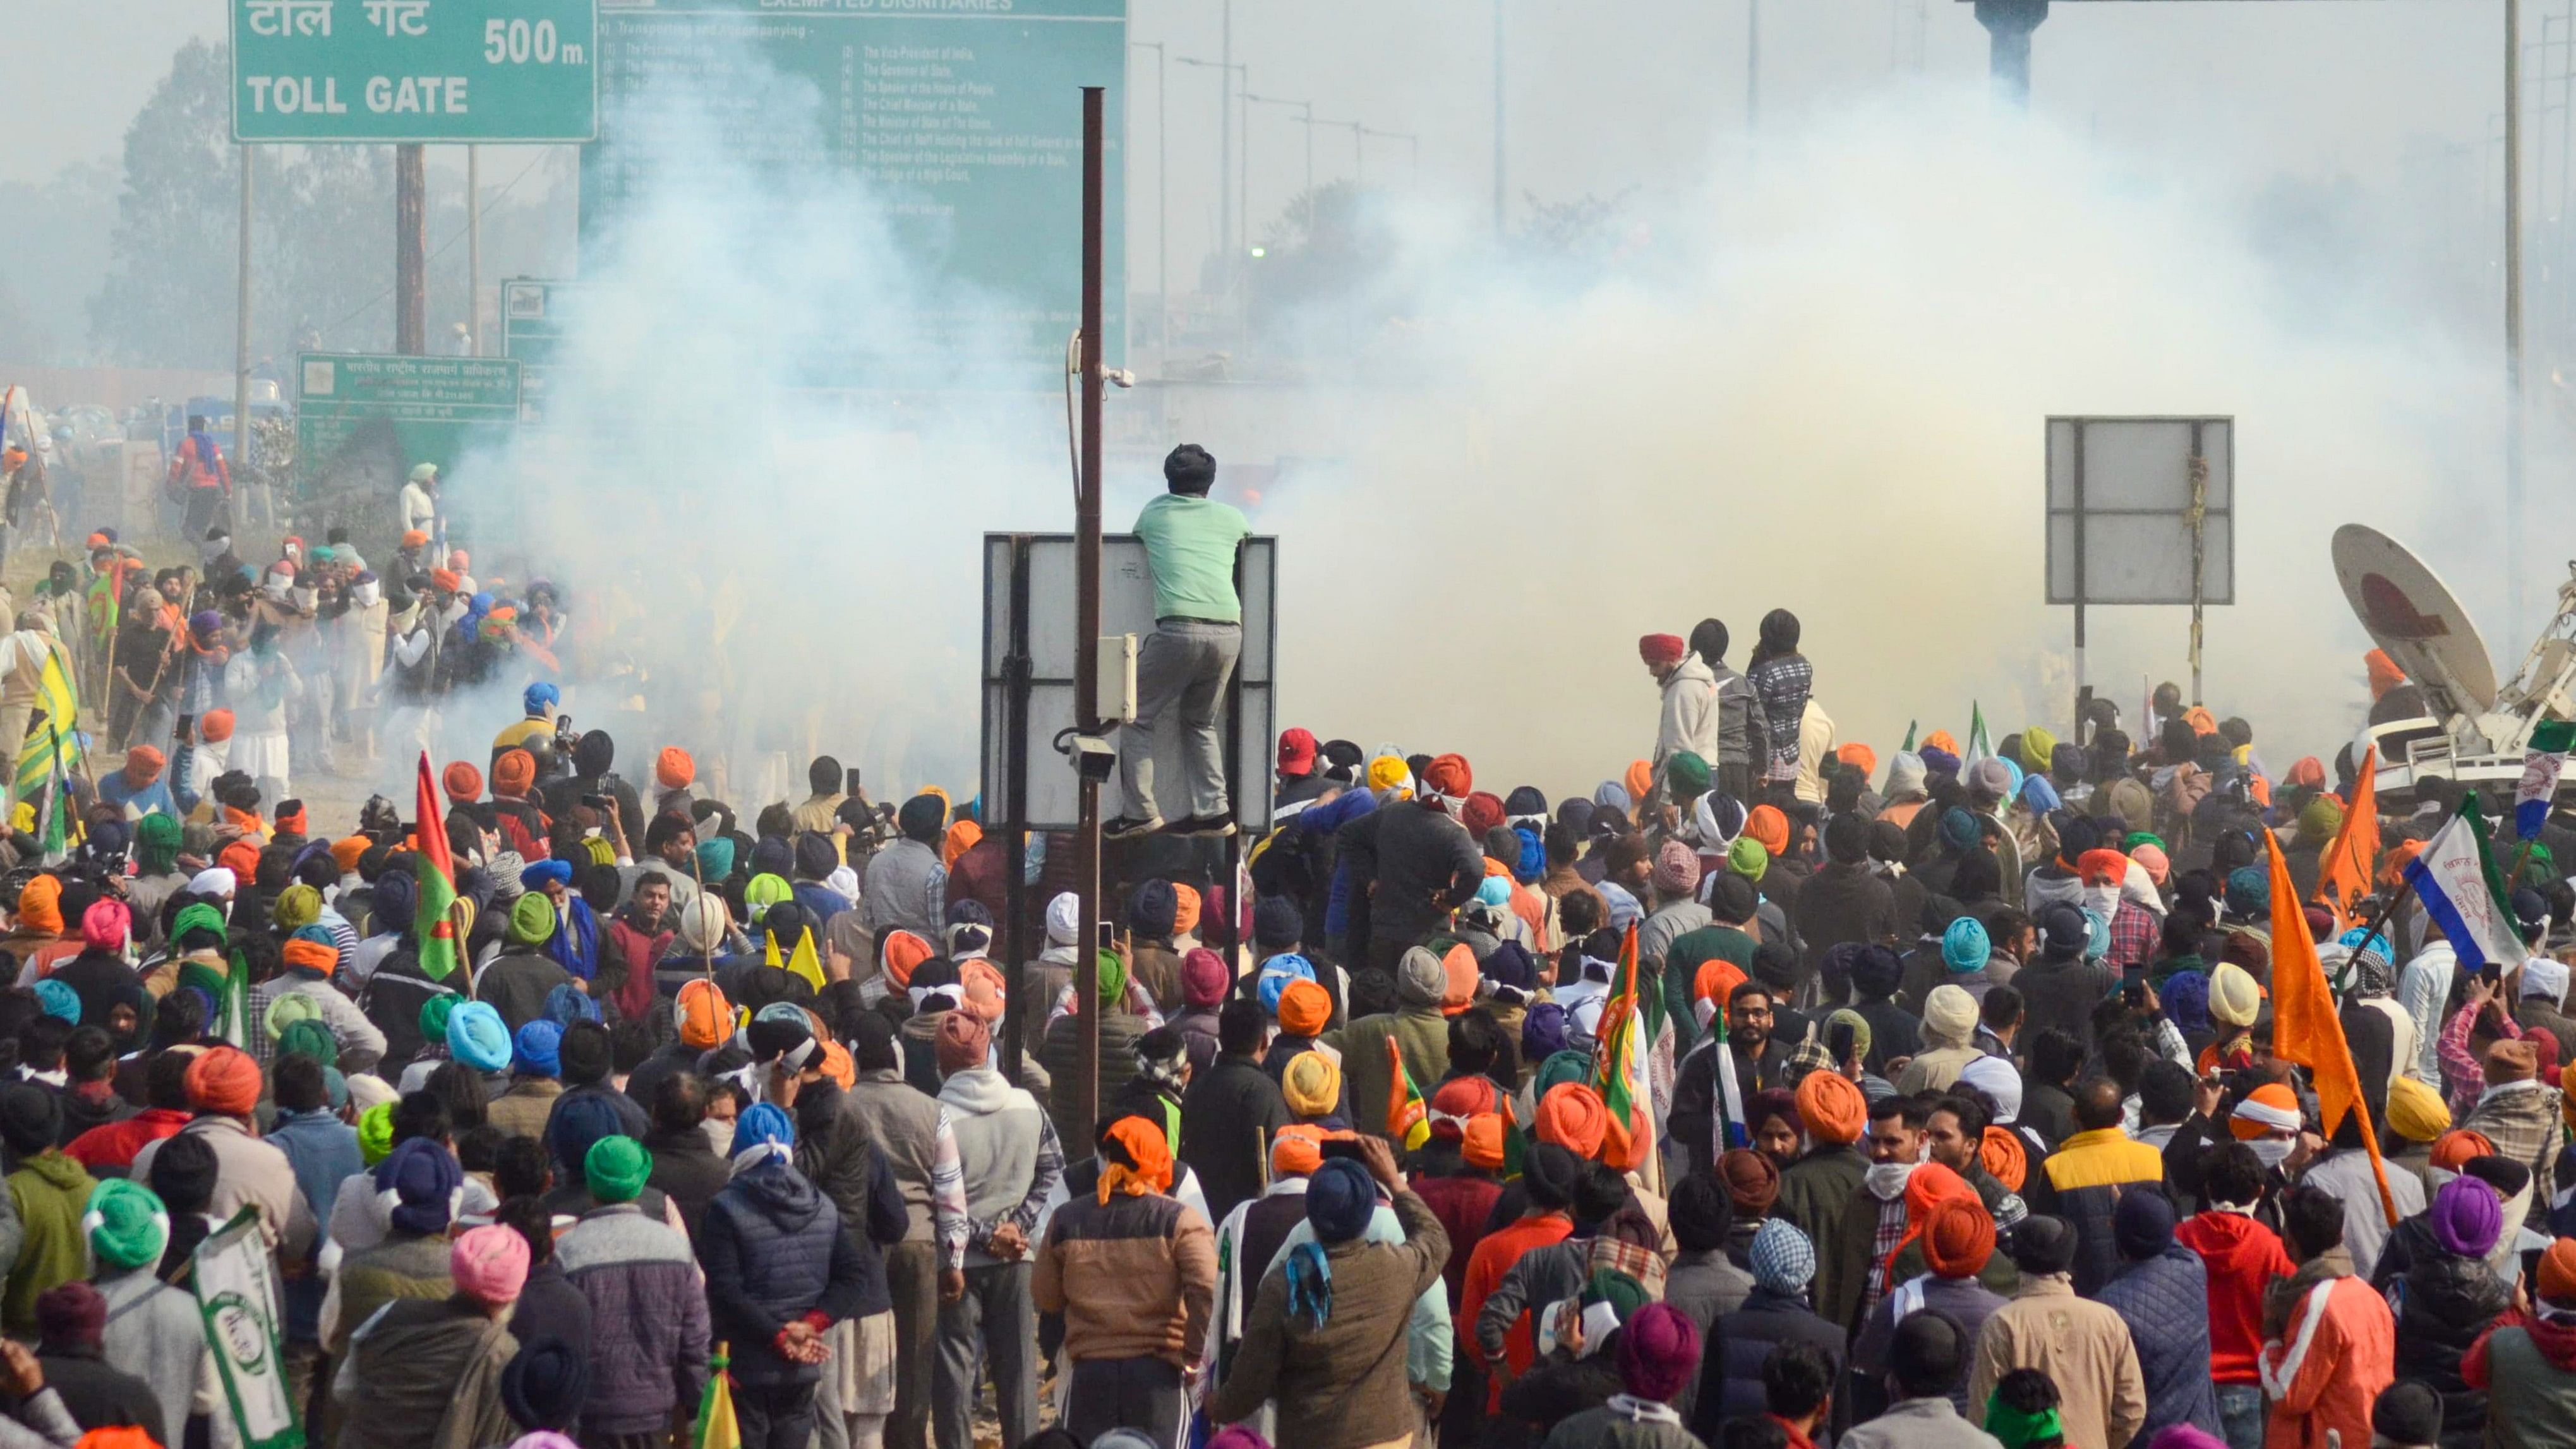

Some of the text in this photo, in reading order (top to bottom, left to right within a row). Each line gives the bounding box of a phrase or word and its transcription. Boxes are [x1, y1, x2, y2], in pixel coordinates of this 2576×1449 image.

[760, 0, 1013, 10] EXEMPTED DIGNITARIES
[484, 19, 588, 65] 500 m.
[865, 45, 879, 59] The
[864, 63, 878, 76] The
[864, 80, 877, 93] The
[246, 76, 468, 113] TOLL GATE
[863, 97, 879, 111] The
[880, 98, 902, 111] Chief
[862, 114, 877, 127] The
[863, 132, 877, 145] The
[879, 132, 901, 146] Chief
[862, 150, 877, 163] The
[987, 152, 1026, 169] Assembly
